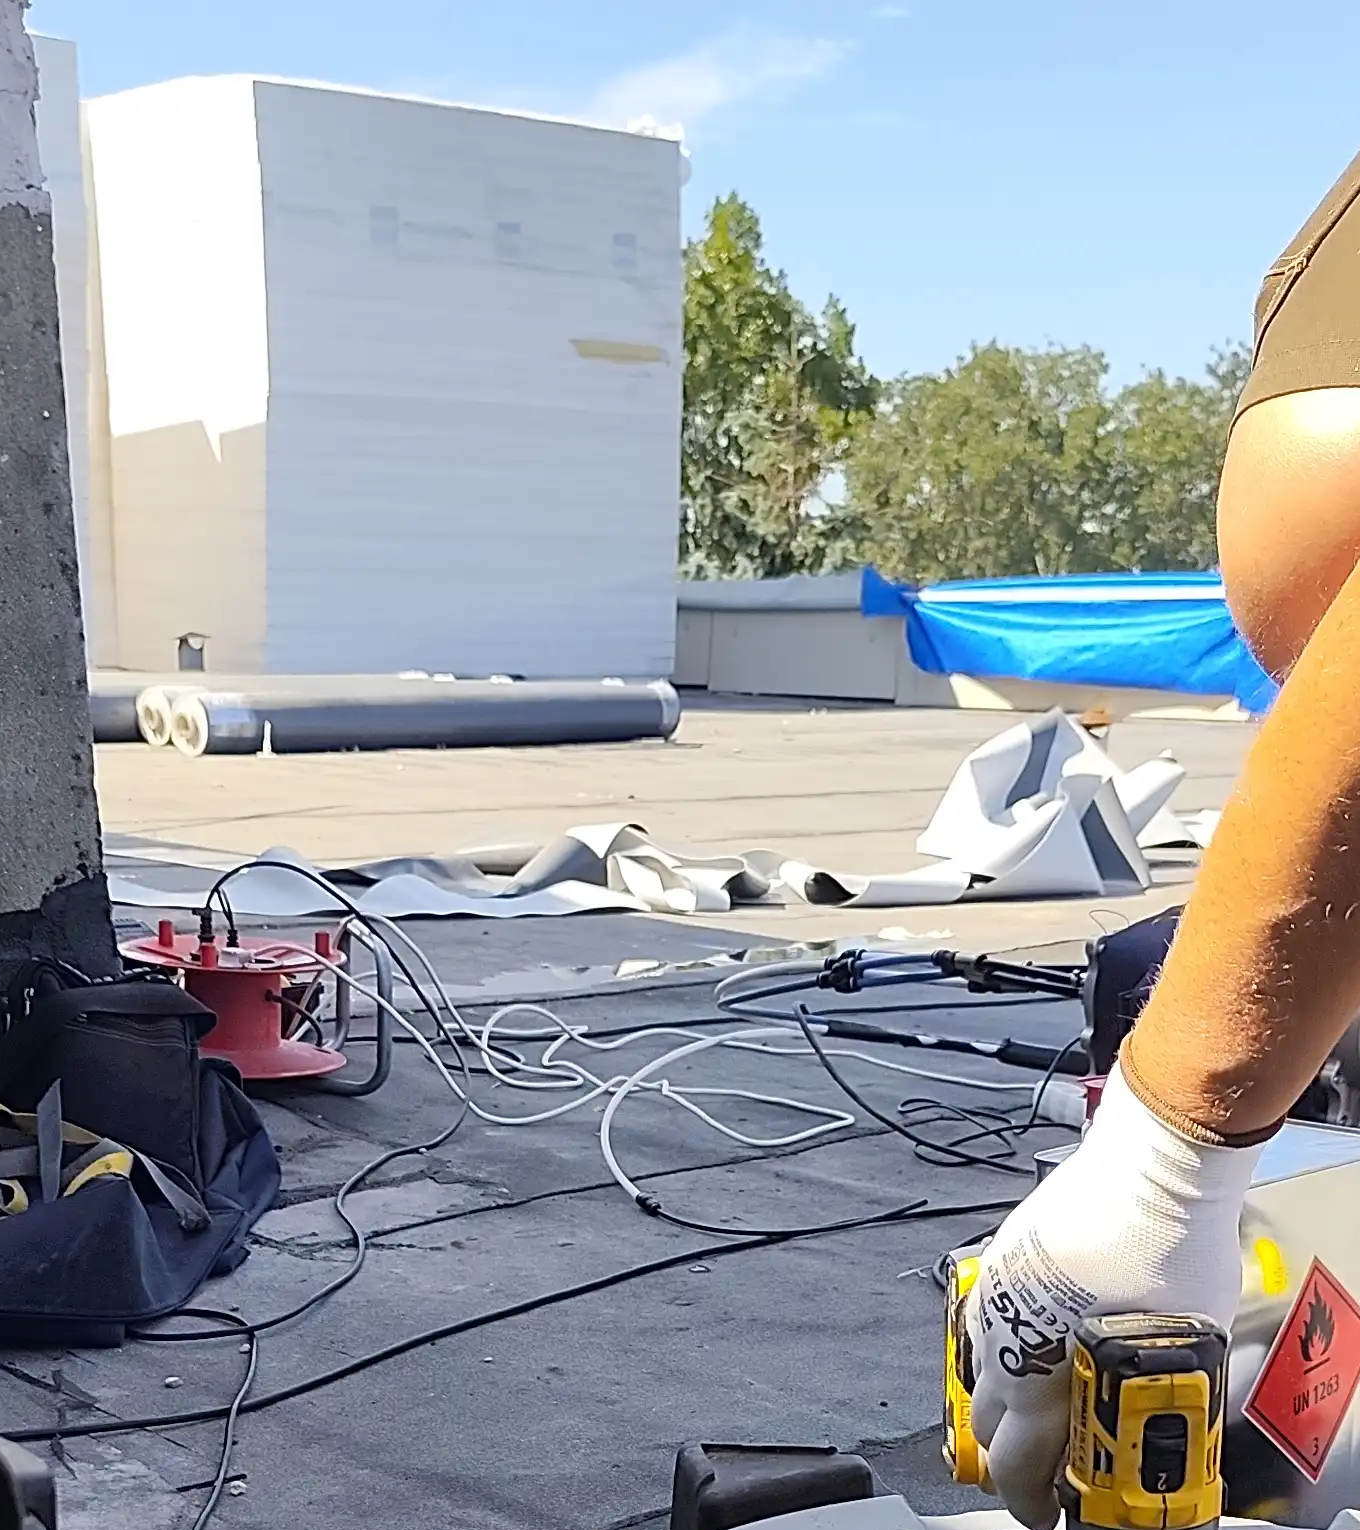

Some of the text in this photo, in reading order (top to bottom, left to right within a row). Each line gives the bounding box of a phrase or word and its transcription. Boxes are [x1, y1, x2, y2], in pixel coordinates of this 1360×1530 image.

[1293, 1373, 1340, 1416] UN 1263
[1312, 1436, 1319, 1456] 3
[1156, 1472, 1169, 1491] 2
